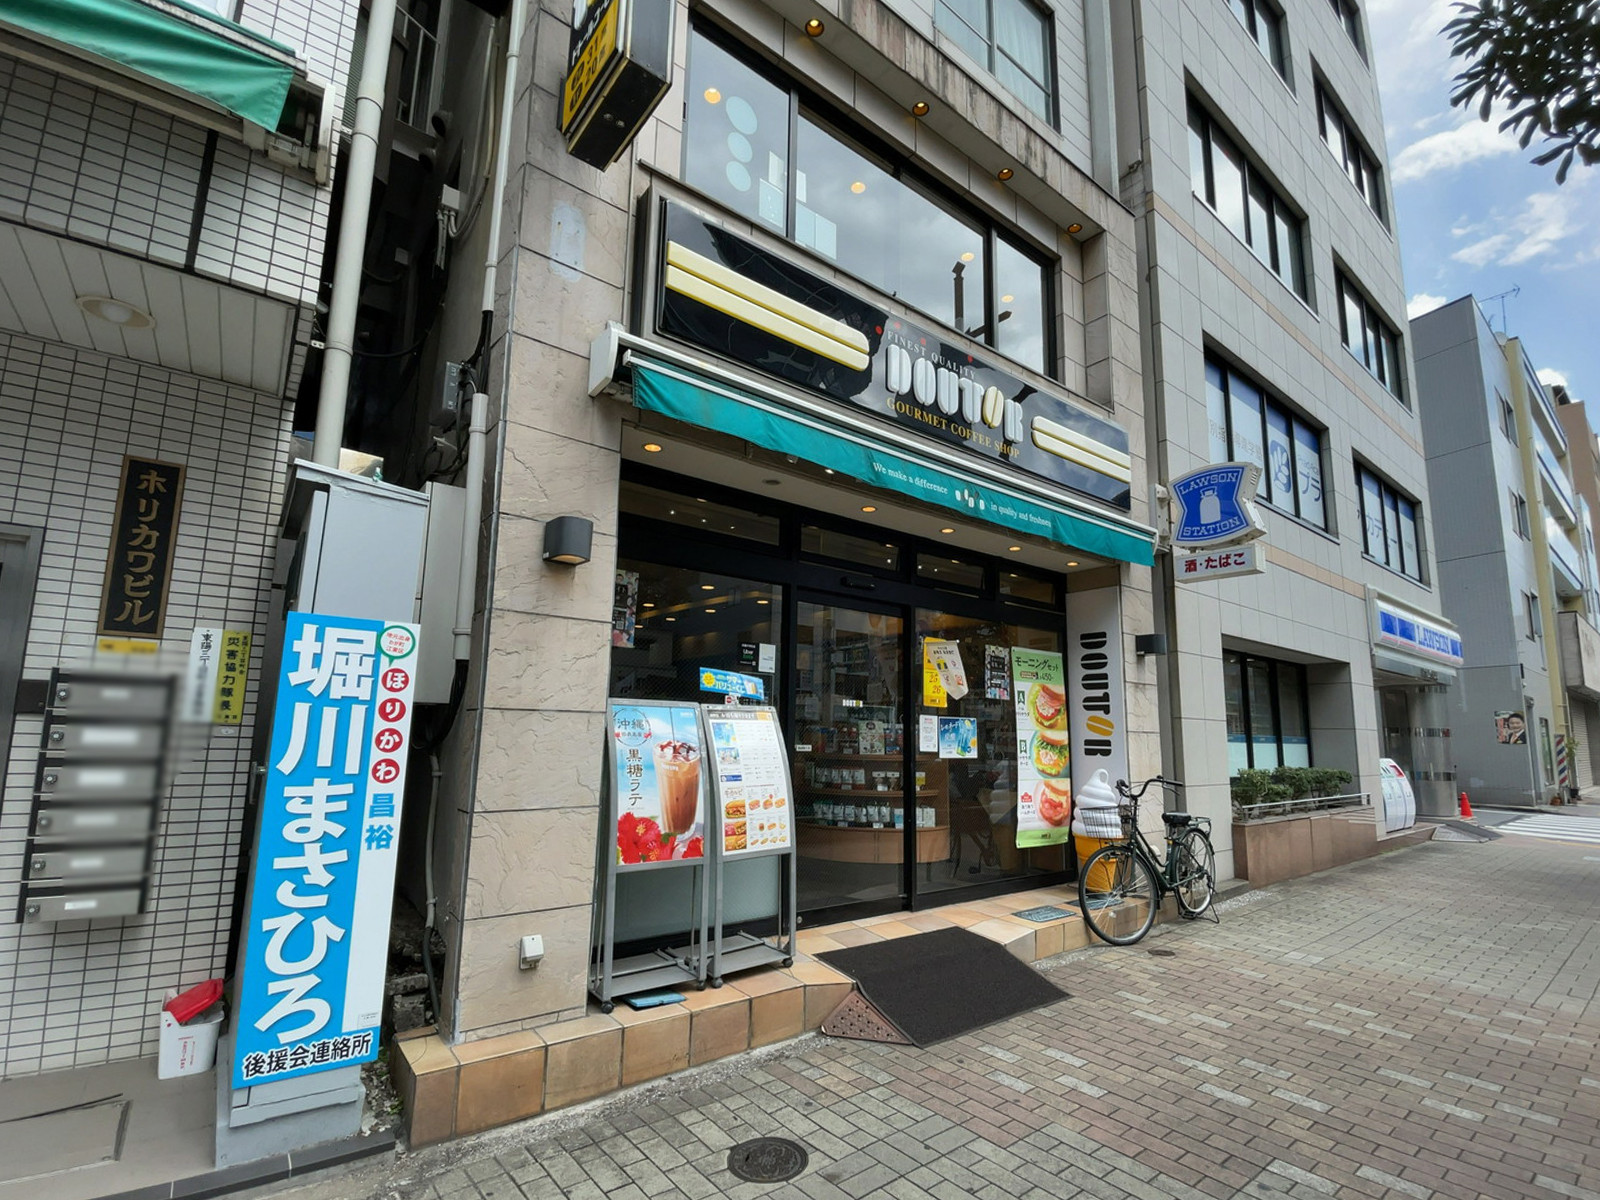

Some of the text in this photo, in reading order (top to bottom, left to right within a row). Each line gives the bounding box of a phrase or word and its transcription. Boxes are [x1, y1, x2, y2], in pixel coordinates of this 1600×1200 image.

[887, 331, 976, 380] FINEST QUALITY
[886, 344, 1024, 443] DOUTOR
[886, 397, 1020, 458] GOURMET COFFEE SHOP
[873, 462, 887, 473] We
[888, 467, 907, 481] make
[914, 477, 948, 494] difference
[990, 503, 998, 511] in
[998, 507, 1017, 519] quality
[1019, 511, 1029, 521] and
[1029, 513, 1051, 528] freshness
[1179, 472, 1238, 495] LAWSON
[113, 469, 167, 626] ホリカワビル
[1183, 516, 1240, 536] STATION
[1185, 552, 1245, 573] 酒・たばこ
[1416, 624, 1451, 655] LAWSON
[1080, 631, 1115, 757] DOUTOR
[374, 670, 407, 781] ほりかわ
[626, 749, 643, 806] 黒糖ラテ
[253, 623, 378, 1044] 堀川まさひろ
[365, 793, 395, 850] 昌裕
[243, 1032, 372, 1079] 後援会連絡所
